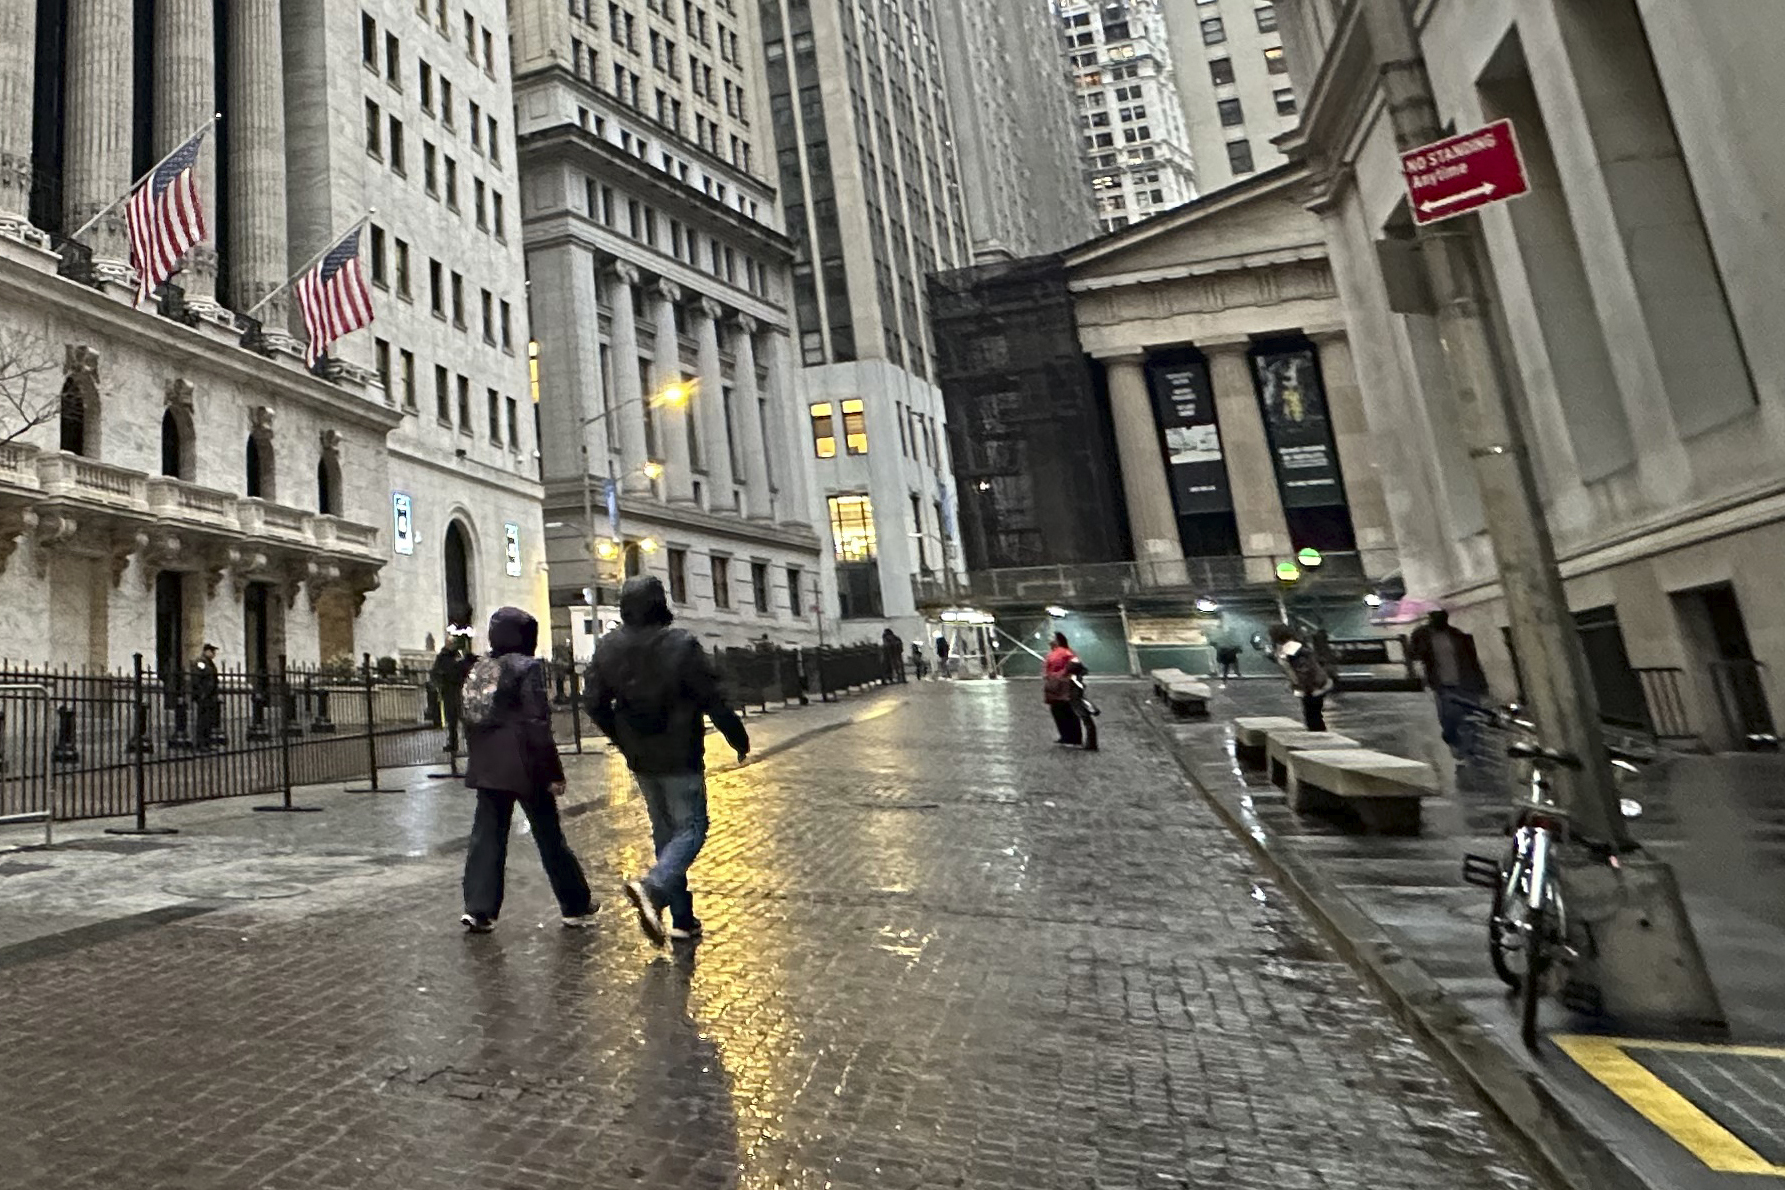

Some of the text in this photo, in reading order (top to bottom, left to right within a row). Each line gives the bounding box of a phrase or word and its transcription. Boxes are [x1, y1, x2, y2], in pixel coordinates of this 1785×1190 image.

[1406, 132, 1496, 173] NO STANDING
[1412, 162, 1469, 189] Anytime
